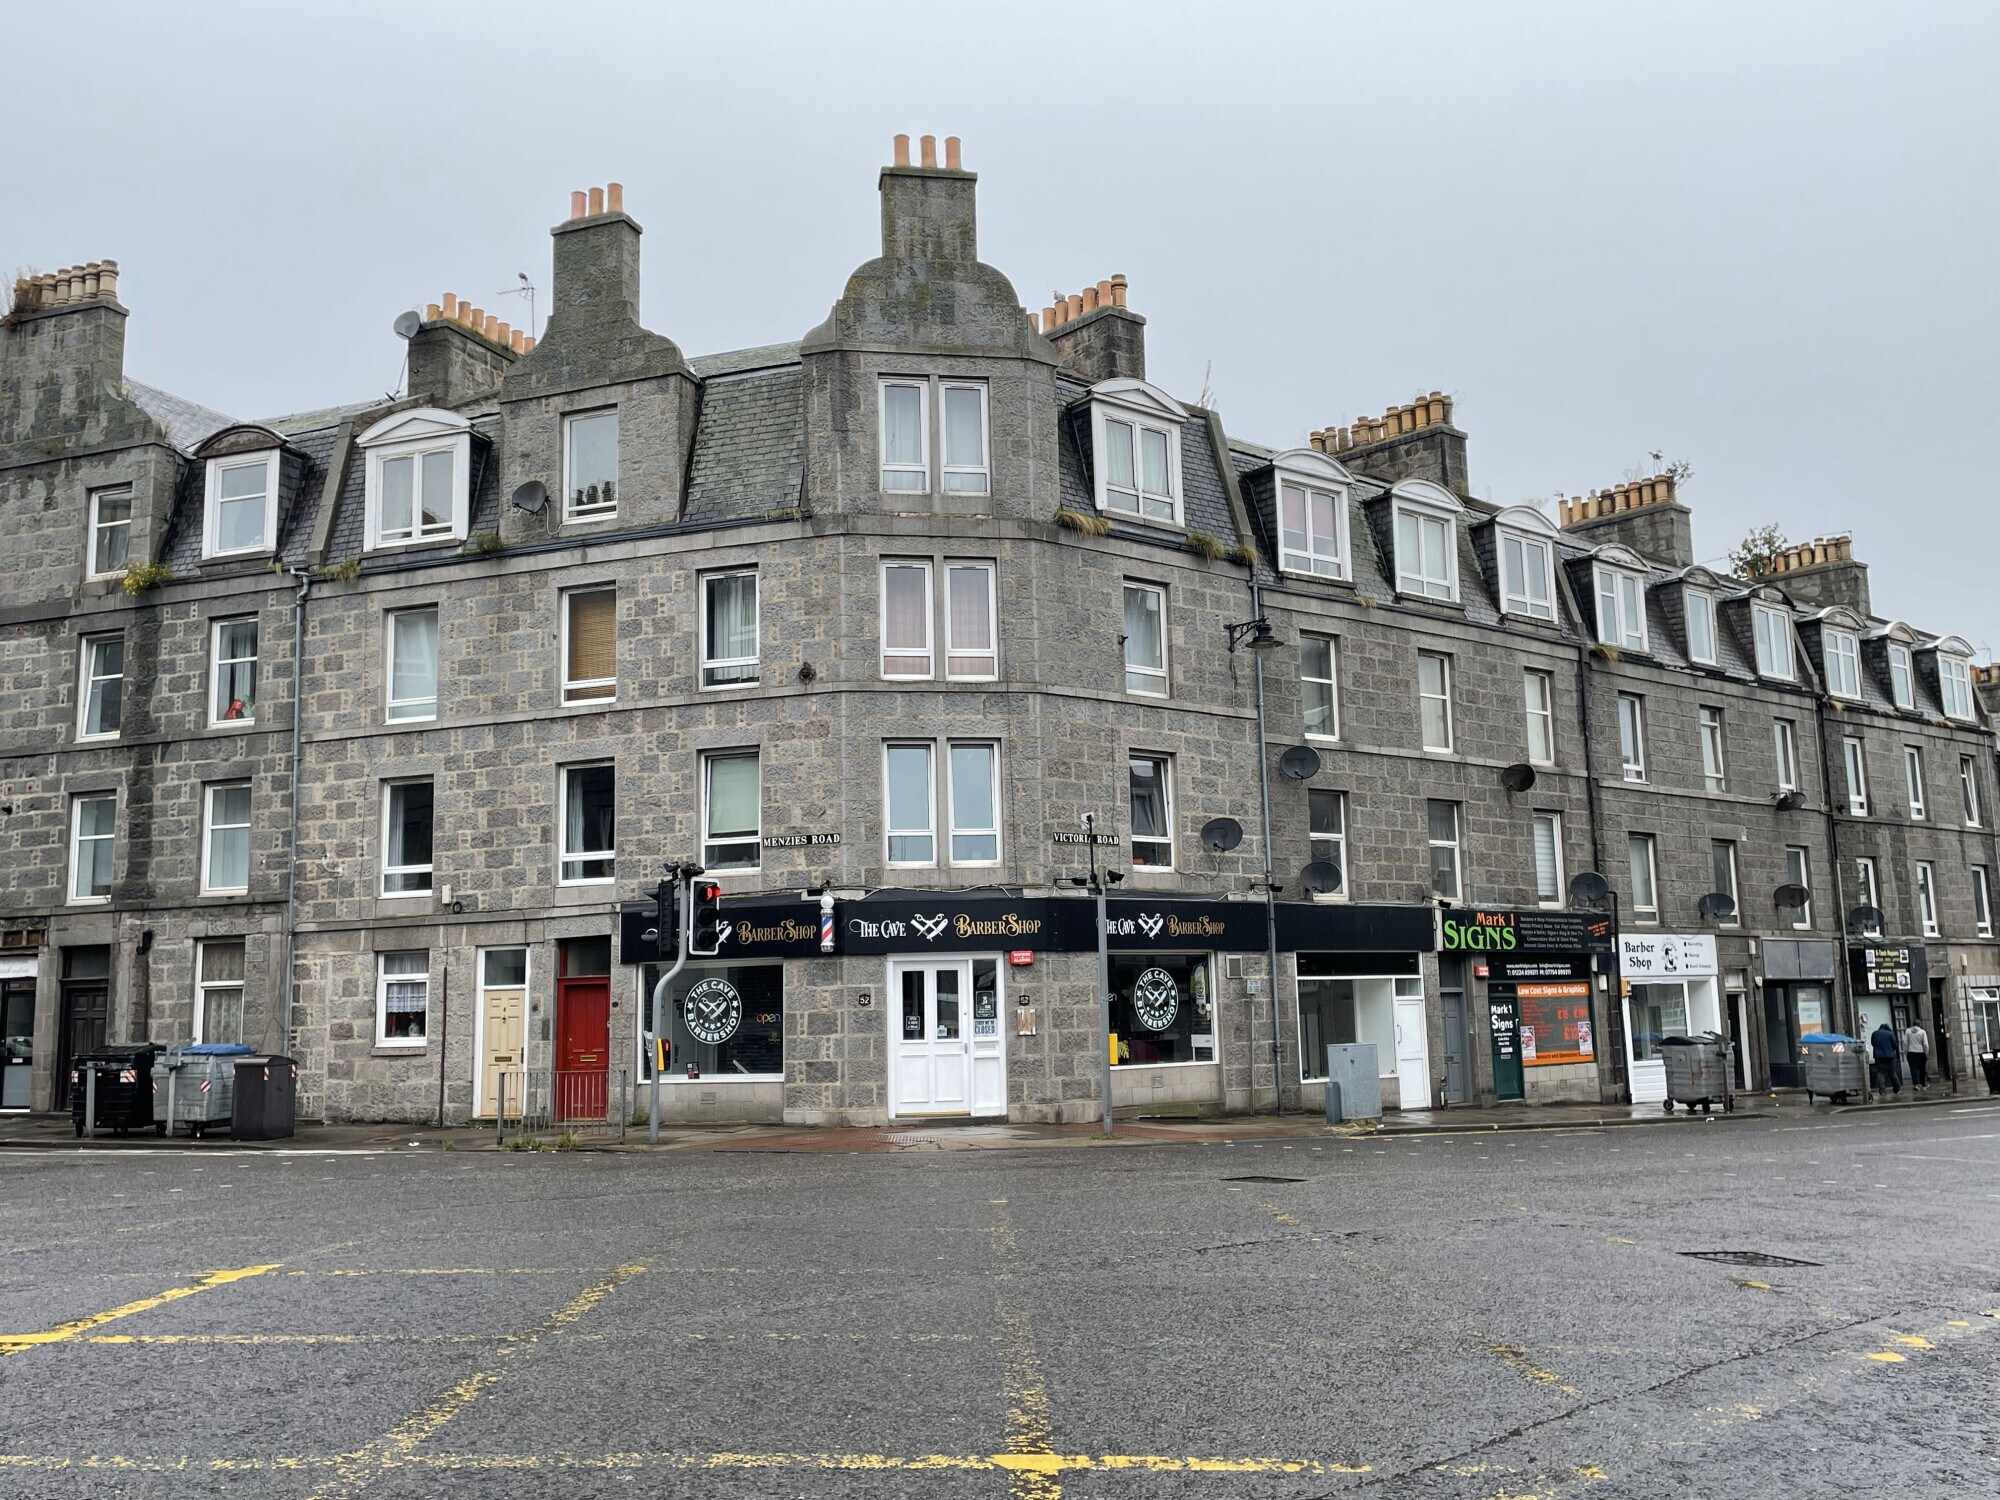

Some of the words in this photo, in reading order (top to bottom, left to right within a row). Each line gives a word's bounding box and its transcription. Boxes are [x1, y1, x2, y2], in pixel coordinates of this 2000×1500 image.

[763, 835, 807, 847] MENZIES
[811, 834, 840, 844] ROAD
[1097, 835, 1119, 845] ROAD
[1476, 912, 1506, 926] Mark
[1510, 913, 1515, 926] 1
[849, 918, 879, 938] THE
[880, 919, 906, 939] CAVE
[1118, 917, 1136, 936] CAVE
[1444, 919, 1517, 950] SIGNS
[1624, 941, 1655, 953] Barber
[1629, 956, 1652, 970] Shop
[1139, 973, 1154, 987] THE
[1154, 970, 1173, 988] CAVE
[691, 982, 708, 999] THE
[711, 981, 735, 999] CAVE
[1518, 987, 1529, 995] Low
[1530, 986, 1542, 995] Cost
[1543, 986, 1558, 996] Signs
[1562, 985, 1586, 995] Graphics
[859, 996, 870, 1004] 52
[1136, 999, 1176, 1028] BARBERSHOP
[1491, 1005, 1508, 1014] Mark
[1508, 1004, 1513, 1014] 1
[687, 1010, 739, 1041] BARBERSHOP
[757, 1013, 780, 1024] open
[1491, 1014, 1514, 1031] Signs
[974, 1026, 995, 1035] CLOSED
